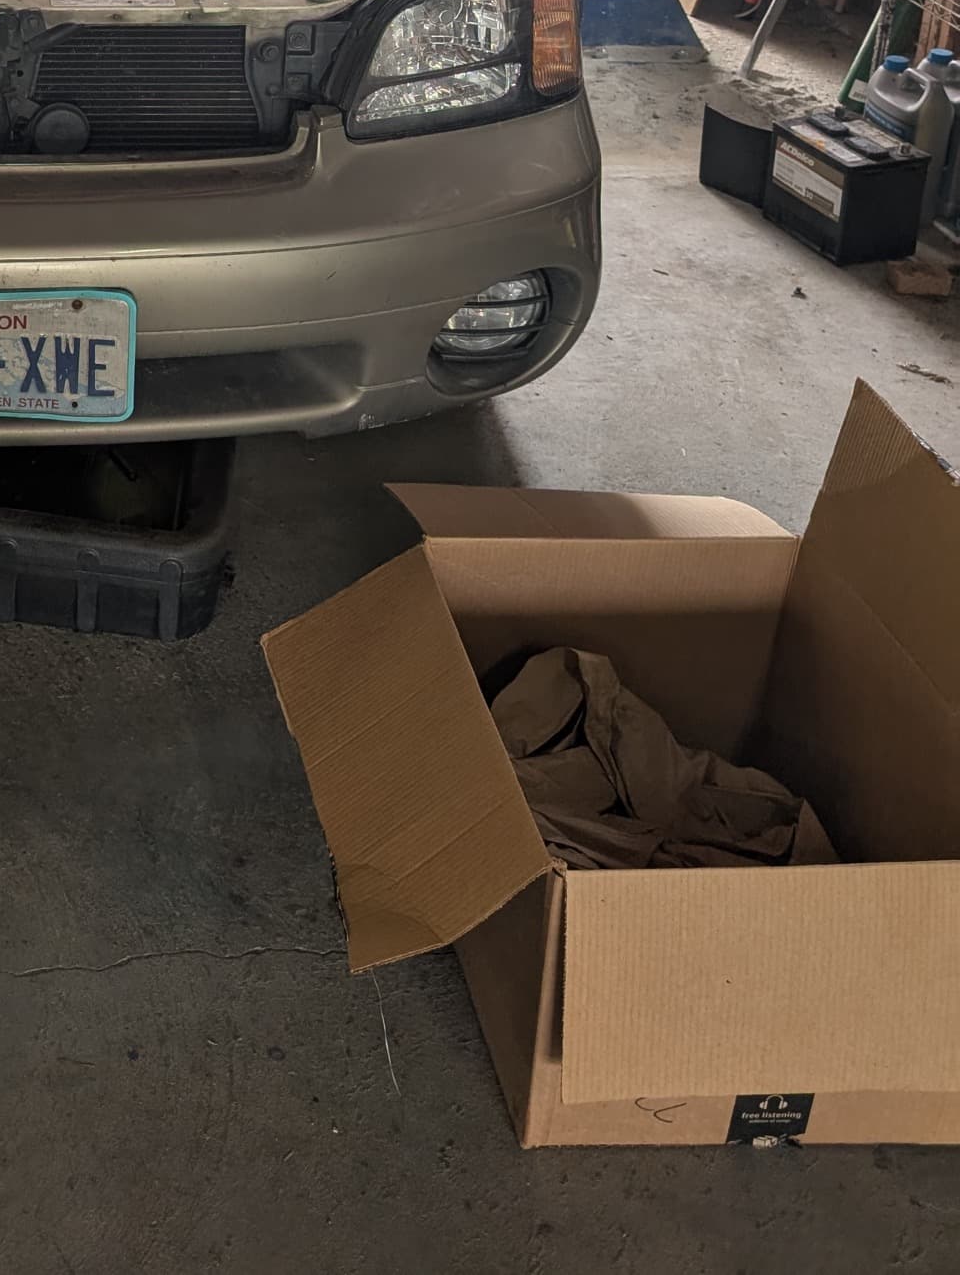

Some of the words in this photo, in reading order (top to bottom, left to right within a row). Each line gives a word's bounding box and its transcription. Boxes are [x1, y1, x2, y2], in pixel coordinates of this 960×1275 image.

[780, 141, 815, 167] ACDelco
[18, 397, 60, 409] STATE
[761, 1111, 802, 1119] listening
